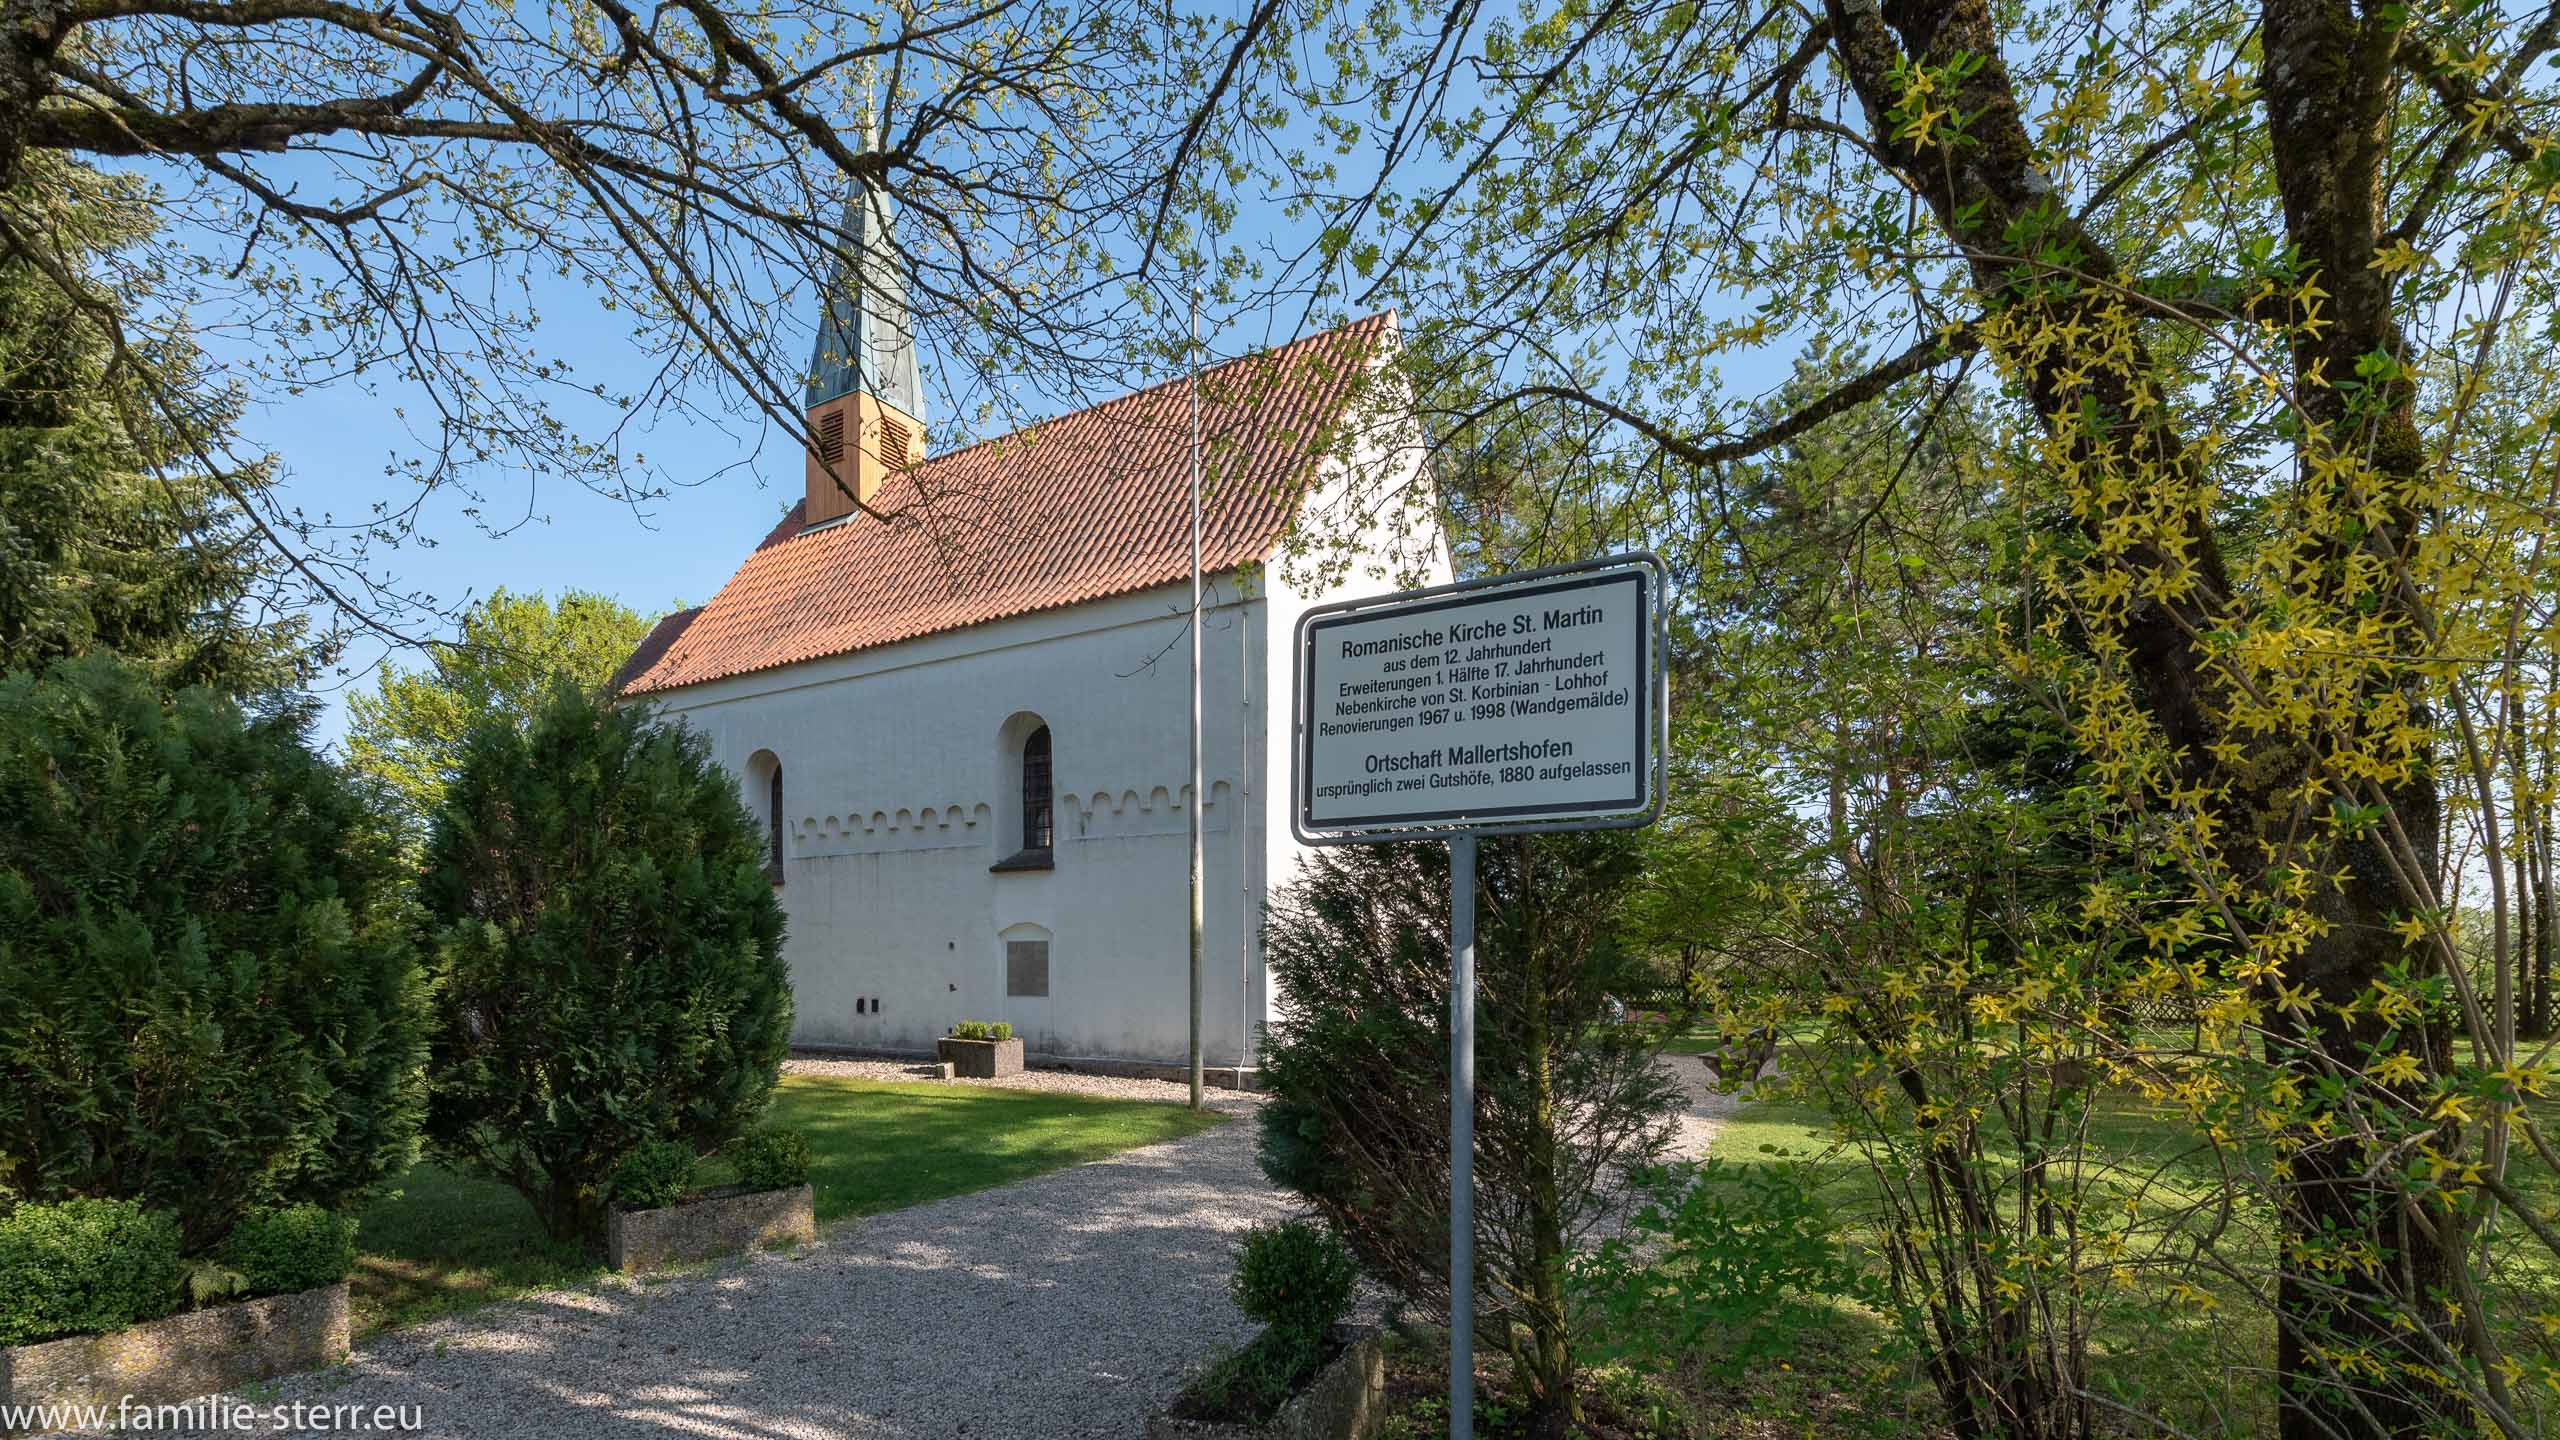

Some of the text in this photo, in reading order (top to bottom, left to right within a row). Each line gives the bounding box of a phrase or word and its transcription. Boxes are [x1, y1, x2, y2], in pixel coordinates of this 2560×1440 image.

[1342, 606, 1603, 659] Romanische Kirche St. Martin
[1340, 651, 1604, 697] Erweiterungen 1. Hälfte 17. Jahrhundert
[1384, 638, 1551, 673] aus dem 12. Jahrhundert
[1320, 688, 1628, 737] Renovierungen 1967 u. 1998 (Wandgemälde)
[1336, 694, 1416, 716] Nebenkirche
[1422, 692, 1444, 706] von
[1449, 687, 1467, 703] St.
[1472, 681, 1539, 700] Korbinian
[1556, 671, 1609, 691] Lohhof
[1365, 739, 1573, 773] Ortschaft Mallertshofen
[1317, 761, 1630, 798] ursprünglich zwei Gutshöfe, 1880 aufgelassen
